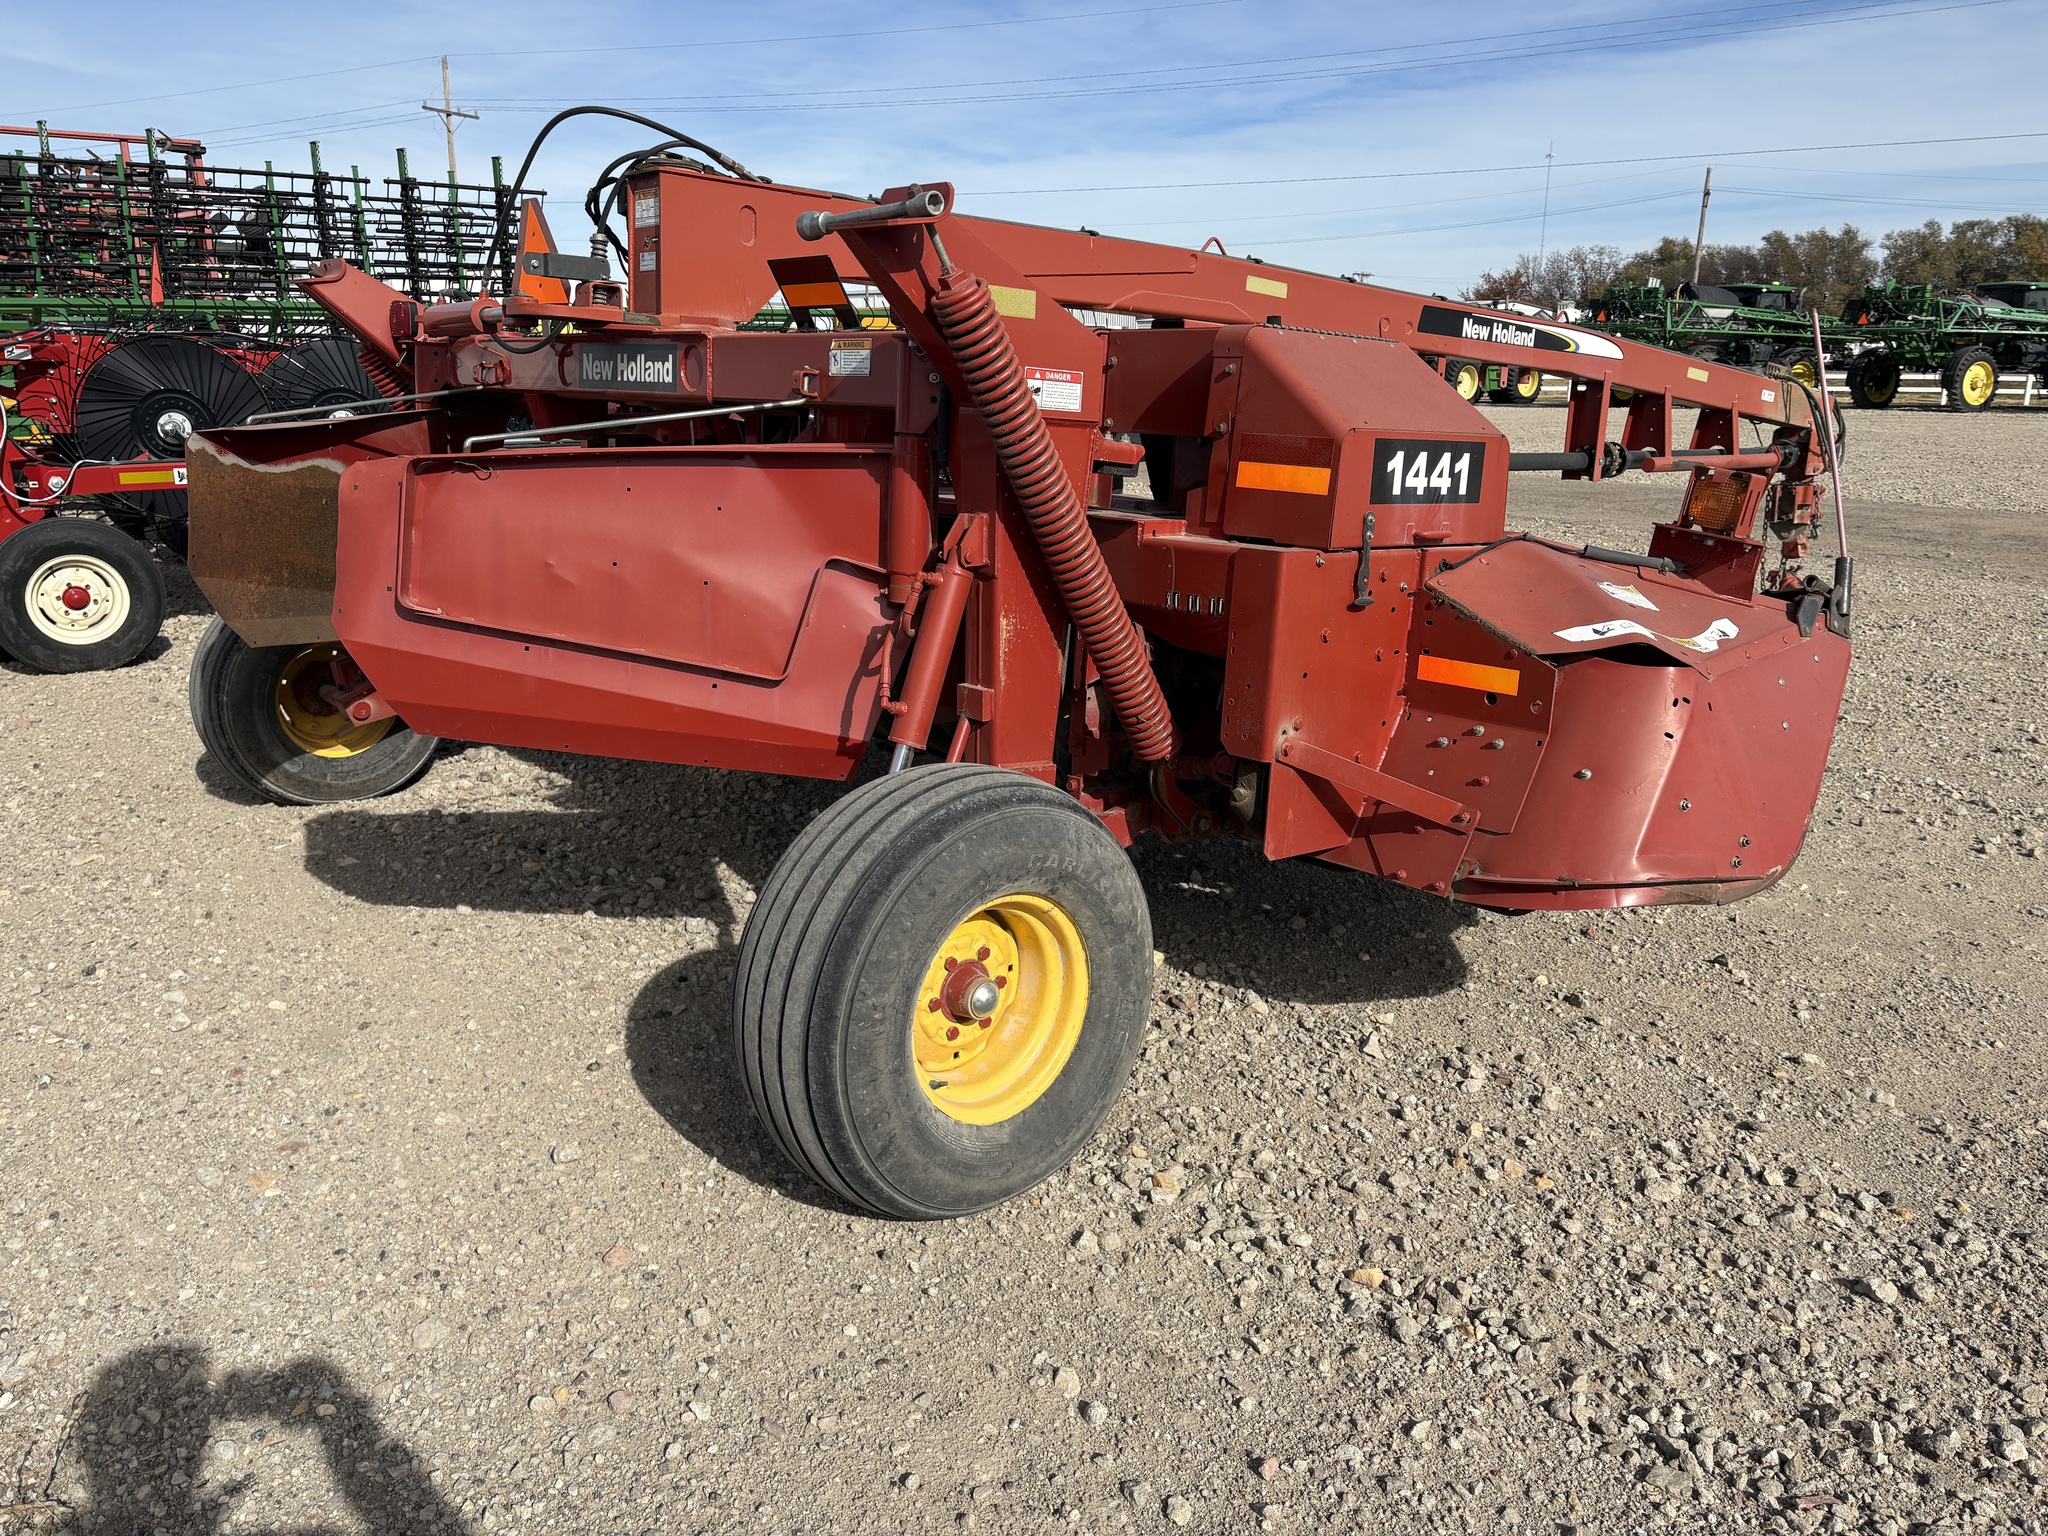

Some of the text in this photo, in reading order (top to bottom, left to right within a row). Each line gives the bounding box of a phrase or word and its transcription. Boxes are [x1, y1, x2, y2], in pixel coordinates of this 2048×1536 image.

[1462, 317, 1536, 347] New Holland
[582, 353, 673, 383] New Holland
[1045, 371, 1072, 381] DANGER
[1387, 450, 1471, 495] 1441
[1027, 852, 1126, 923] CARLISLE
